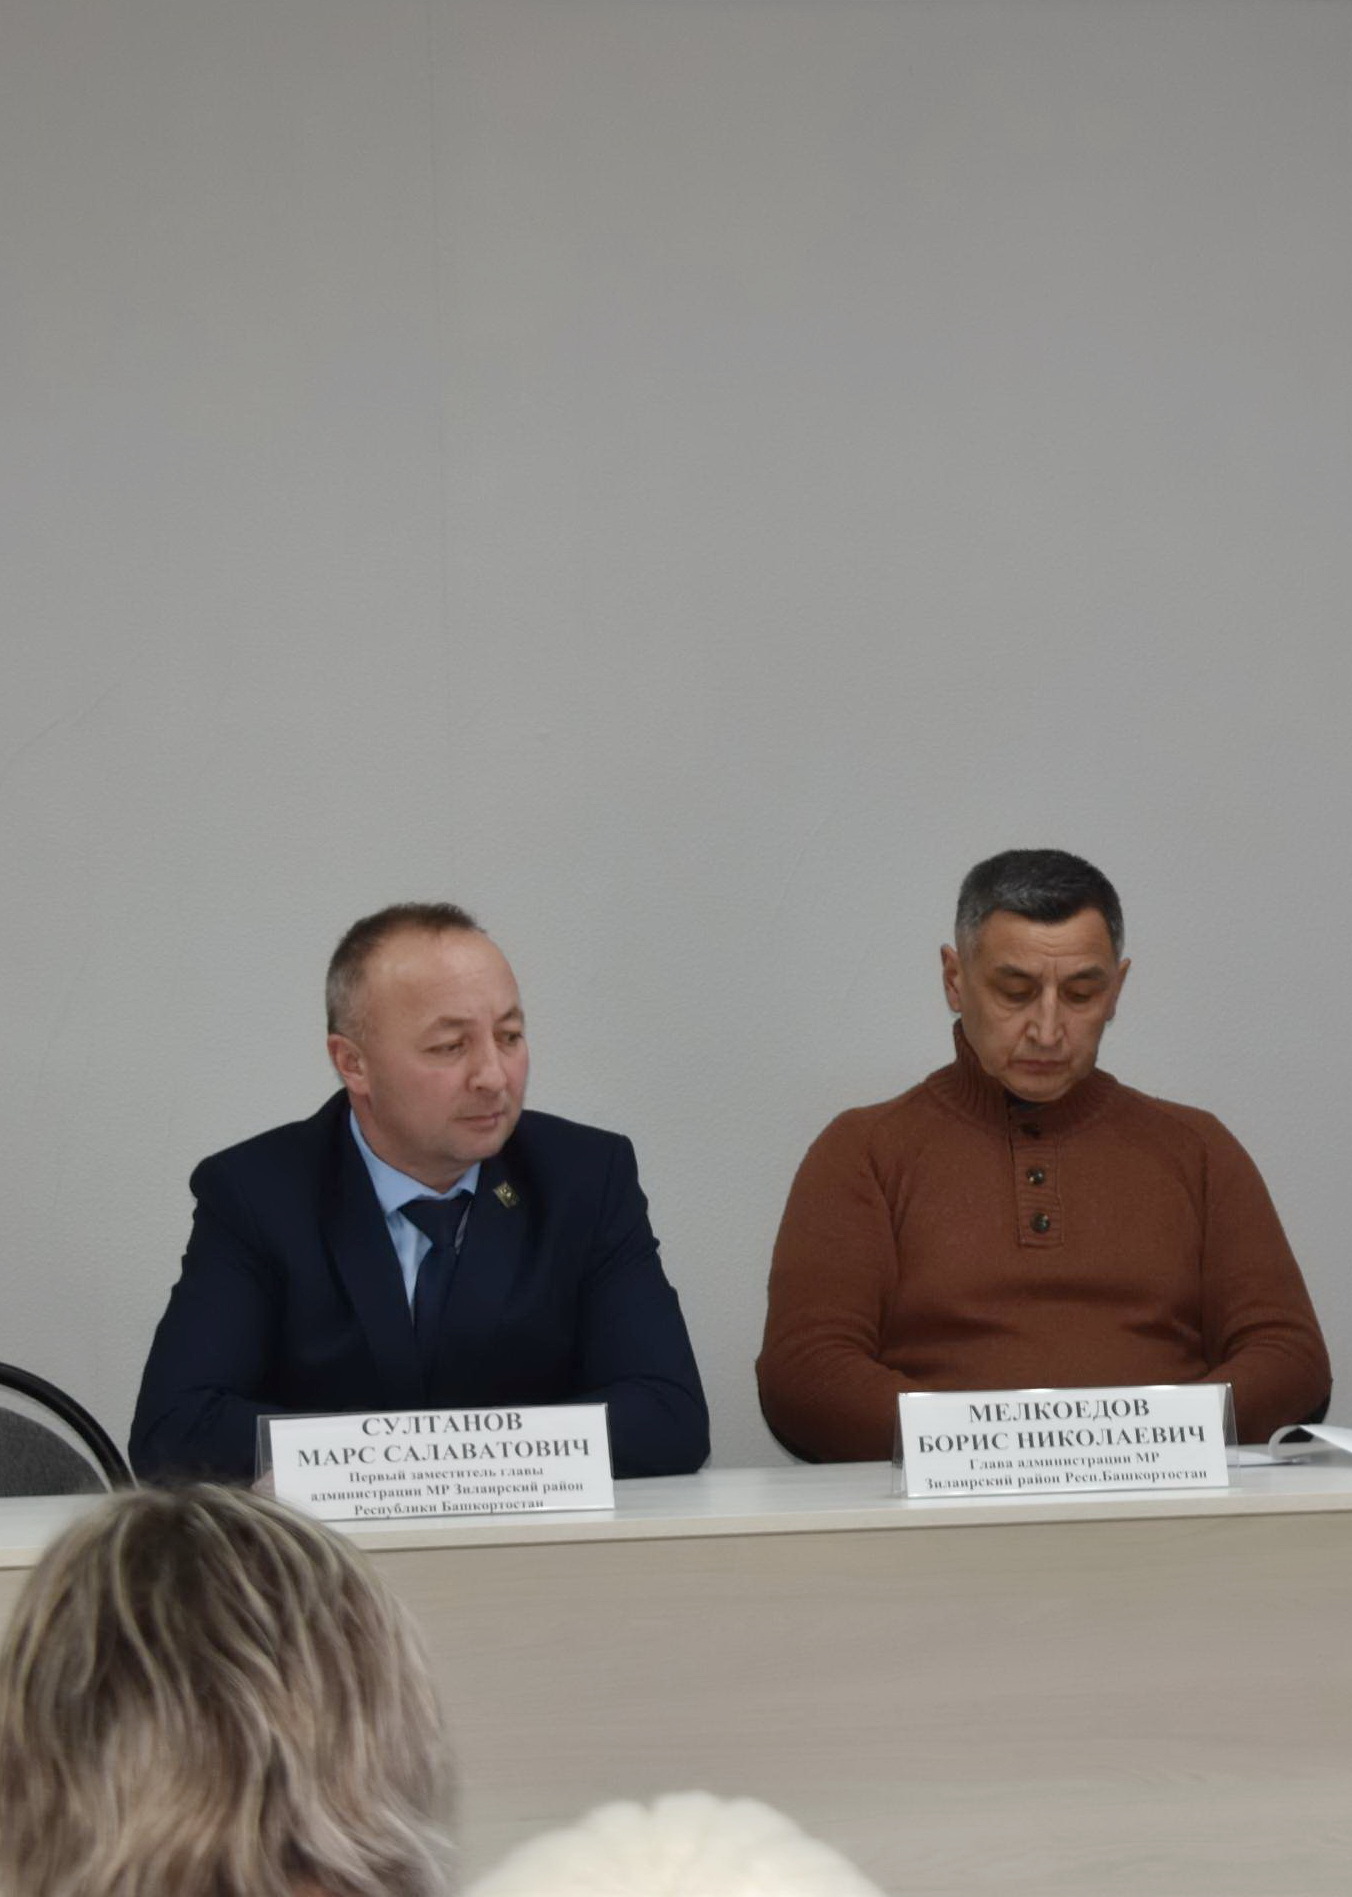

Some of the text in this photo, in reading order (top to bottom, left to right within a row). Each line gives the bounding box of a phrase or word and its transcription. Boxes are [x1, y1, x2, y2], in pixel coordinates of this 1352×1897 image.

[969, 1398, 1150, 1423] МЕЛКОЕДОВ
[361, 1411, 524, 1437] СУЛТАНОВ
[918, 1425, 1206, 1454] БОРИС НИКОЛАЕВИЧ
[298, 1438, 589, 1467] МАРС САЛАВАТОВИЧ
[970, 1452, 1160, 1470] Глава администрации МР
[349, 1467, 544, 1485] Первый заместитель главы
[925, 1475, 1013, 1490] Зилаирский
[1018, 1473, 1060, 1488] район
[311, 1480, 584, 1501] администрации МР Зилаирский район
[354, 1500, 544, 1519] Республики Башкортостан
